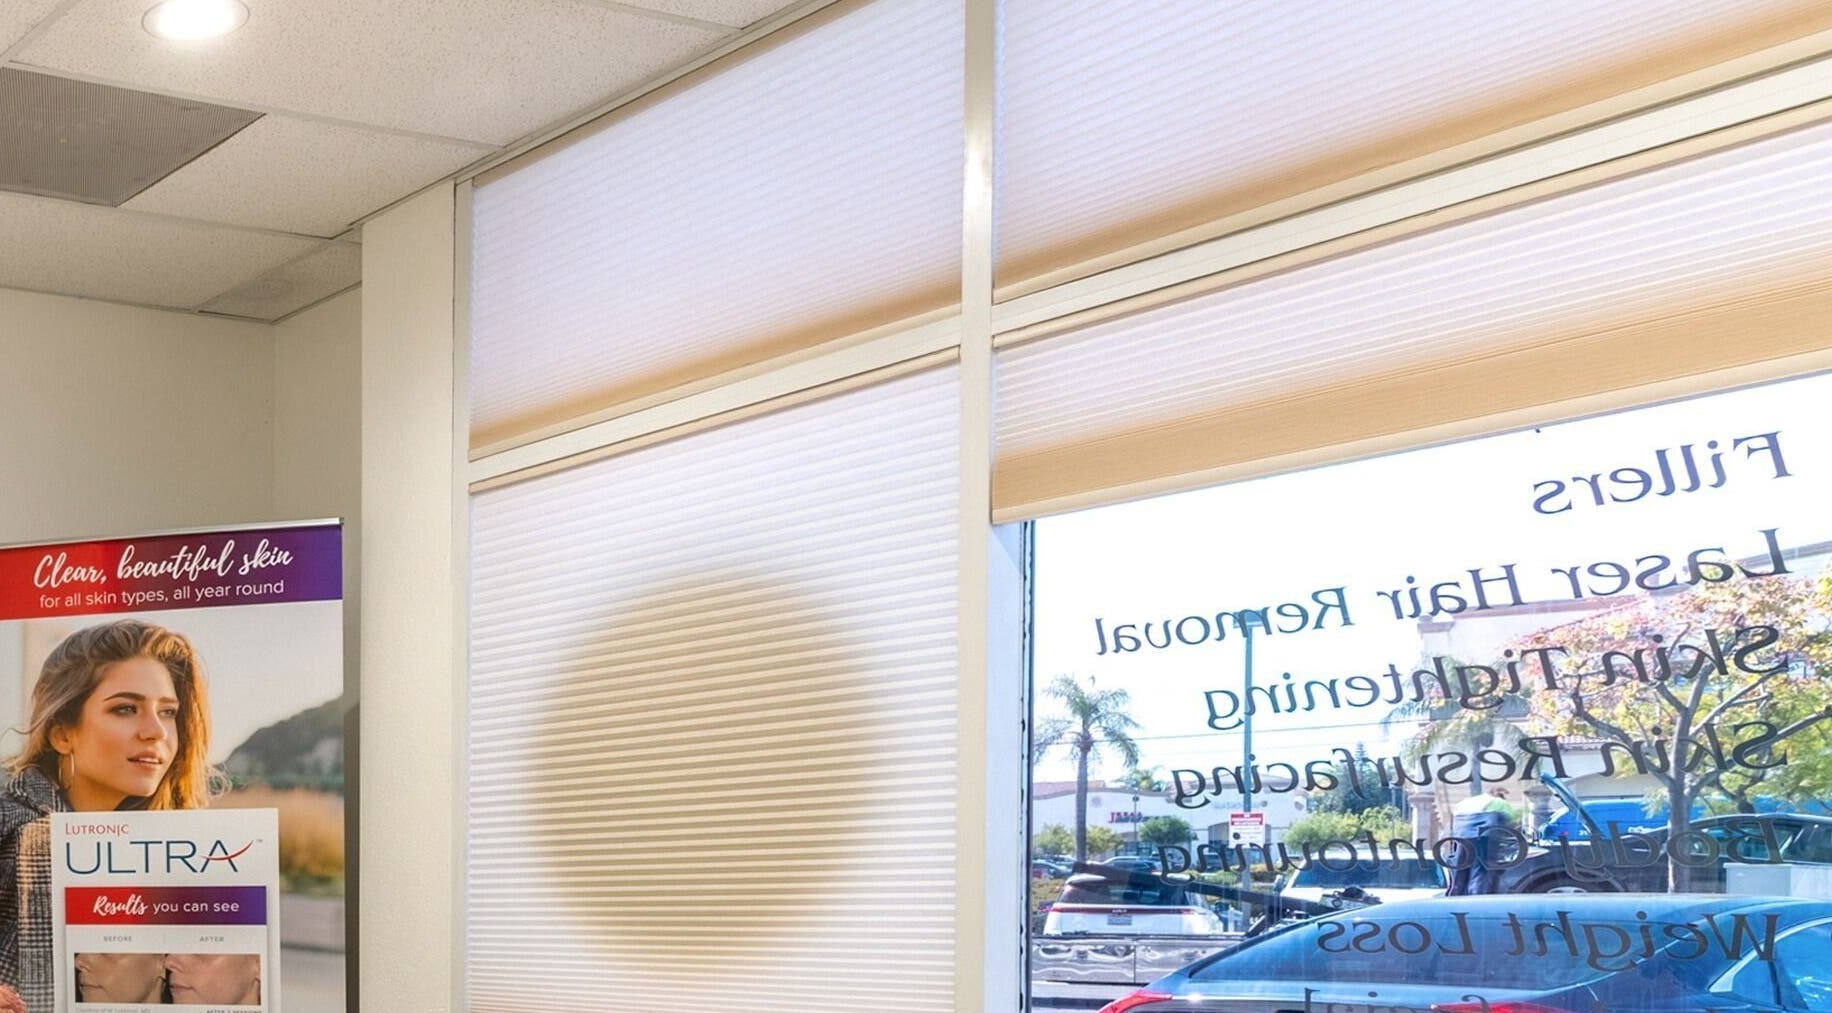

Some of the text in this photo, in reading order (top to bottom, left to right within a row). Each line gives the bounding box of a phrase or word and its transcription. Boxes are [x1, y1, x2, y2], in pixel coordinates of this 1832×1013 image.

[33, 539, 294, 589] Clear, beautiful skin
[40, 579, 285, 609] for all skin types, all year round
[93, 893, 240, 917] Results you can see
[103, 935, 224, 943] BEFORE AFTER
